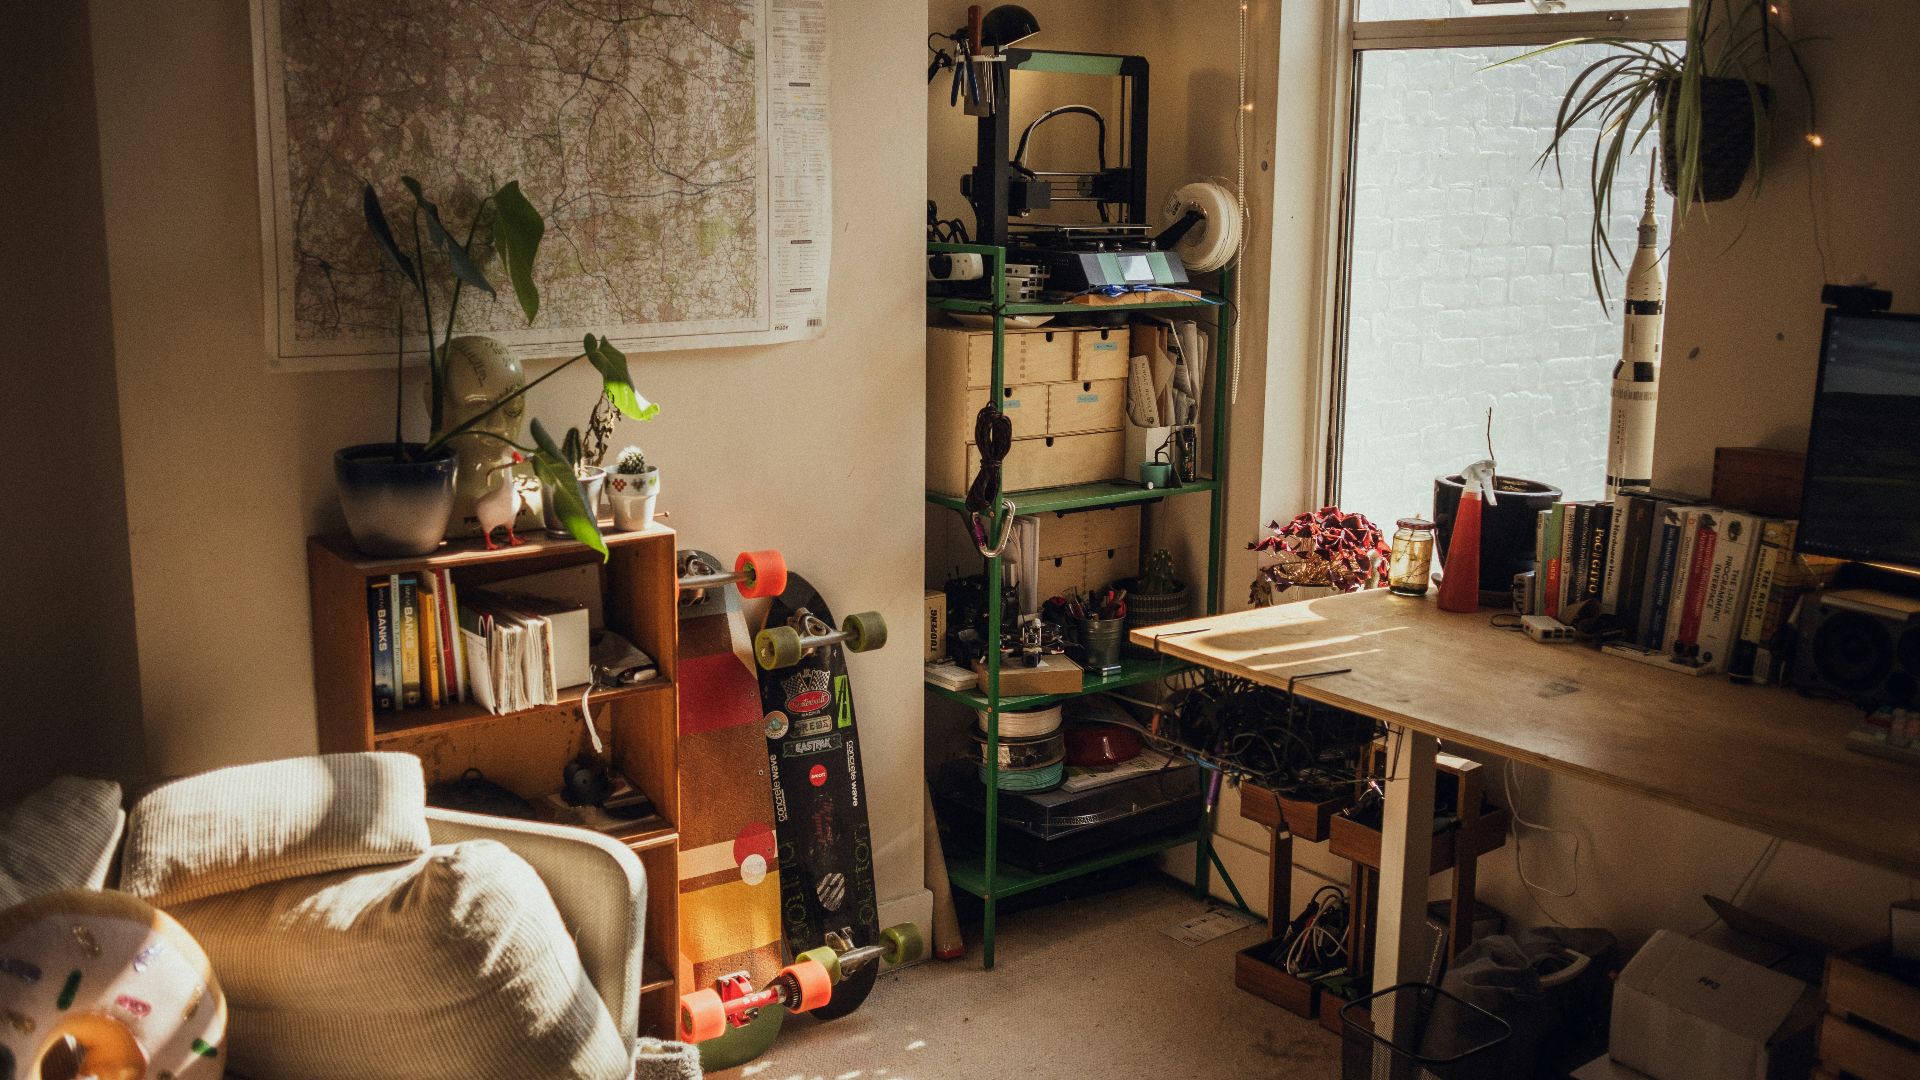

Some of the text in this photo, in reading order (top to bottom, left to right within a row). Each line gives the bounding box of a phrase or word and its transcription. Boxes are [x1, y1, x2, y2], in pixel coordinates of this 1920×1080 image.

[1706, 563, 1722, 610] INTERFACE
[1712, 555, 1733, 623] PROGRAMMING
[1729, 569, 1739, 586] THE
[1755, 570, 1771, 620] THE RUST
[376, 609, 388, 652] BANKS
[404, 606, 413, 649] BANKS
[769, 754, 780, 780] wave
[848, 740, 857, 780] concrete
[772, 780, 785, 822] concrete
[851, 781, 859, 807] wave
